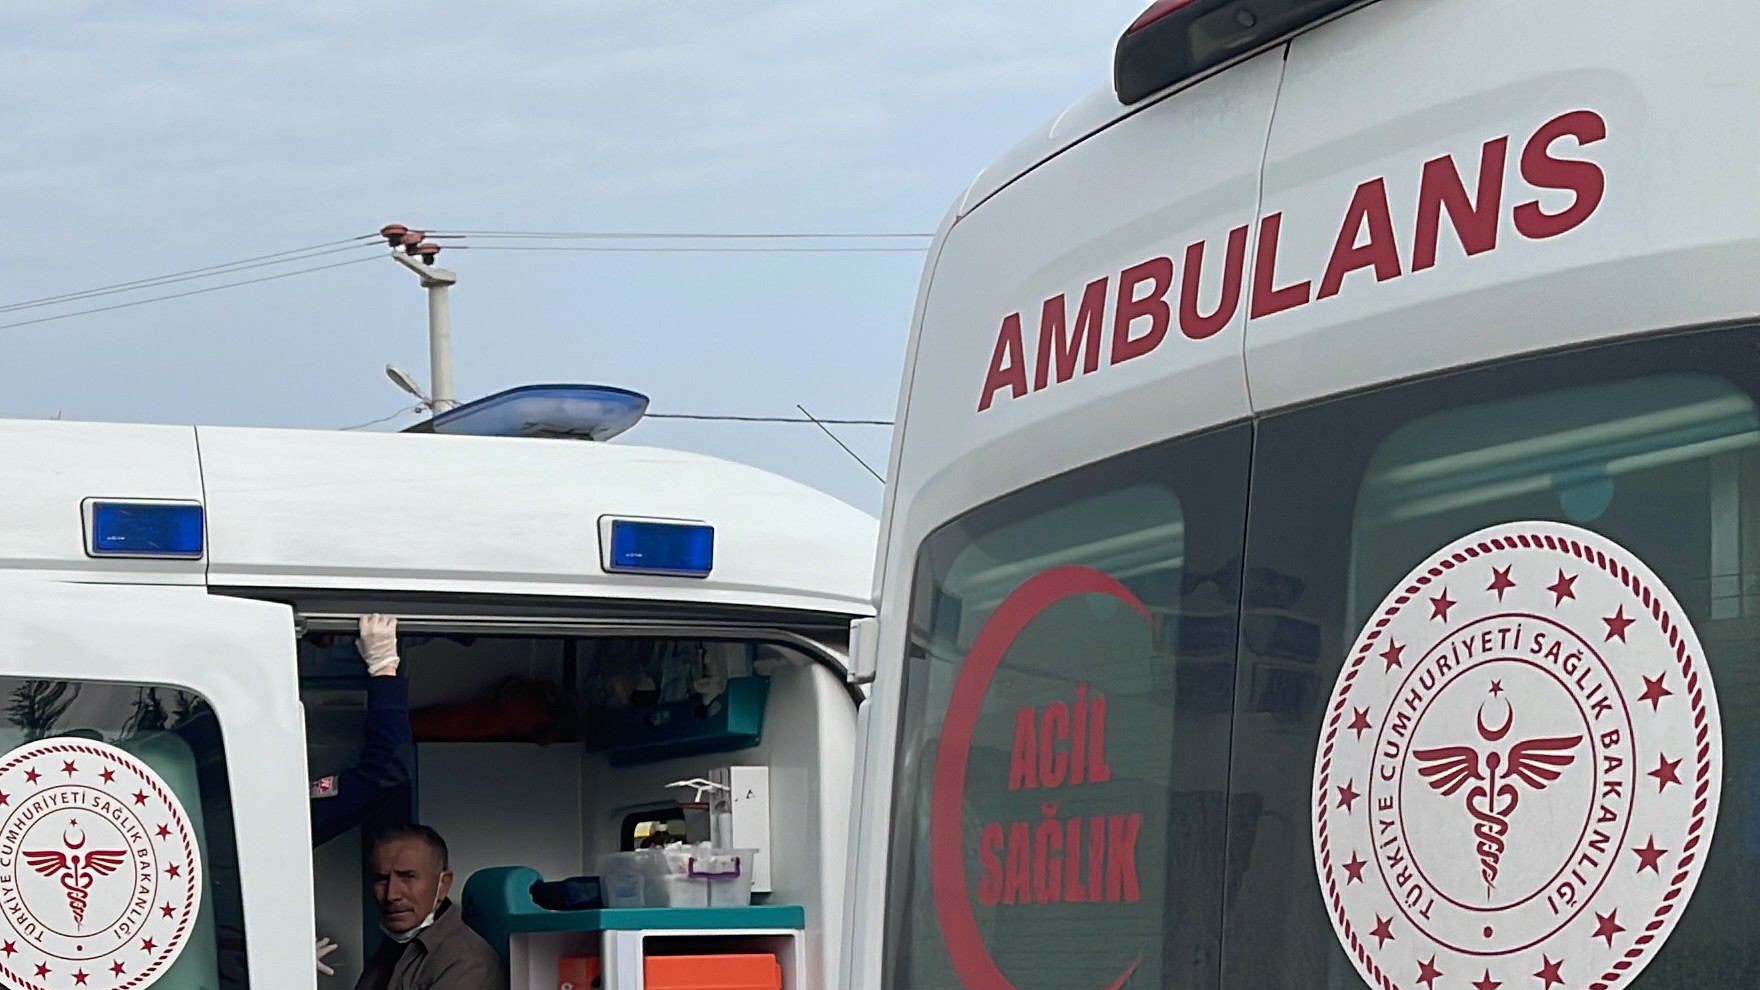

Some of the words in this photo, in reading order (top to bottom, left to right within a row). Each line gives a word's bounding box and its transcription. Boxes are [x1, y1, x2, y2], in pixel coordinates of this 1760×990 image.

[977, 110, 1607, 412] AMBULANS
[1380, 623, 1522, 781] CUMHURİYETİ
[1530, 631, 1613, 721] SAĞLIK
[1008, 681, 1111, 792] ACİL
[0, 790, 86, 867] CUMHURİYETİ
[91, 795, 142, 844] SAĞLIK
[977, 802, 1143, 907] SAĞLIK
[1378, 796, 1435, 920] TÜRKİYE
[1547, 729, 1622, 915] BAKANLIĞI
[0, 874, 44, 943] TÜRKİYE
[114, 848, 152, 940] BAKANLIĞI
